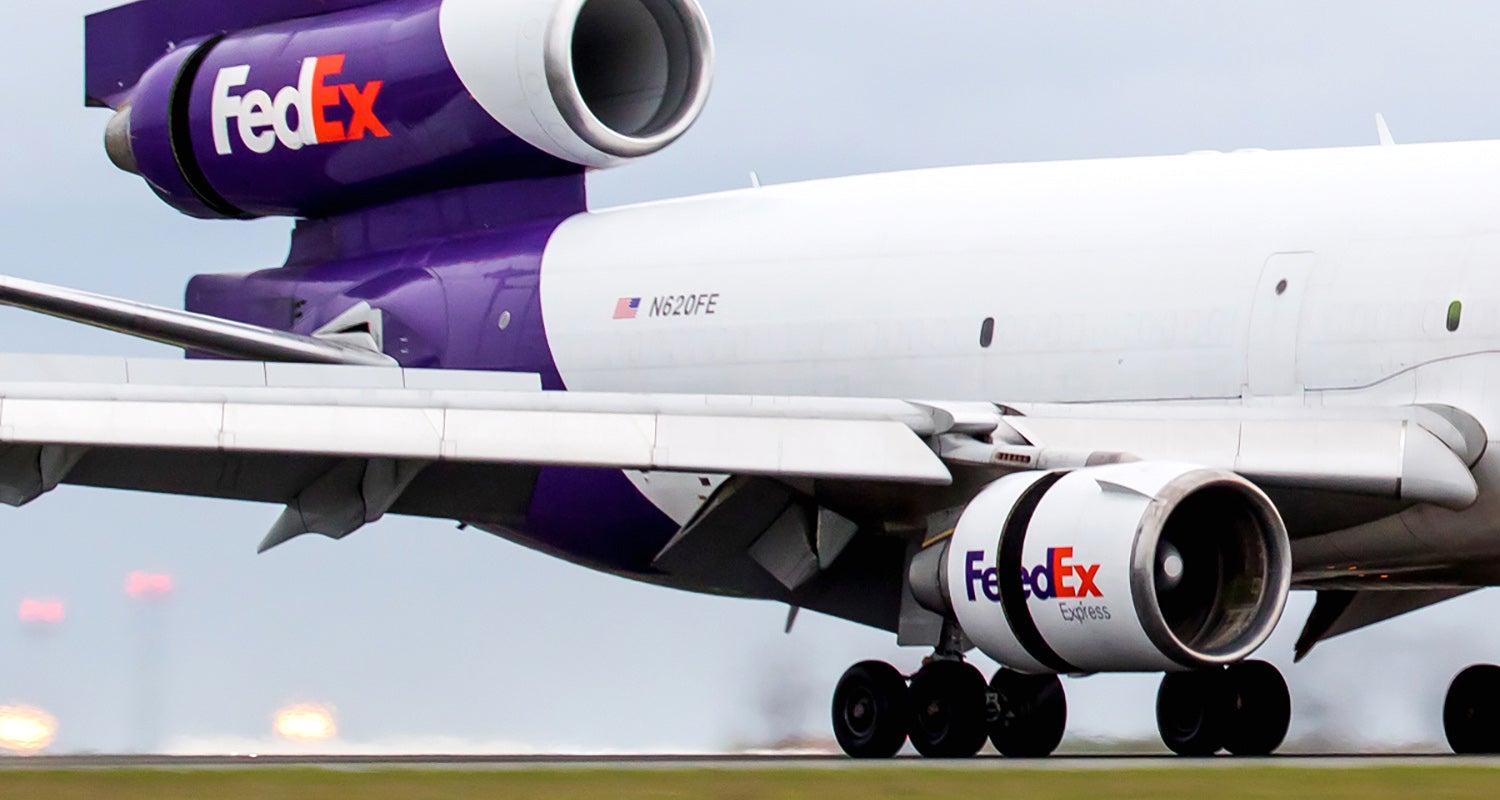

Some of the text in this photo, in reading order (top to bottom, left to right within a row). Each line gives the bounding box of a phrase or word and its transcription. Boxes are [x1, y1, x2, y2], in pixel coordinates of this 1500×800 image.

[211, 53, 392, 155] FedEx
[648, 293, 720, 318] N620FE
[1059, 600, 1112, 624] Express
